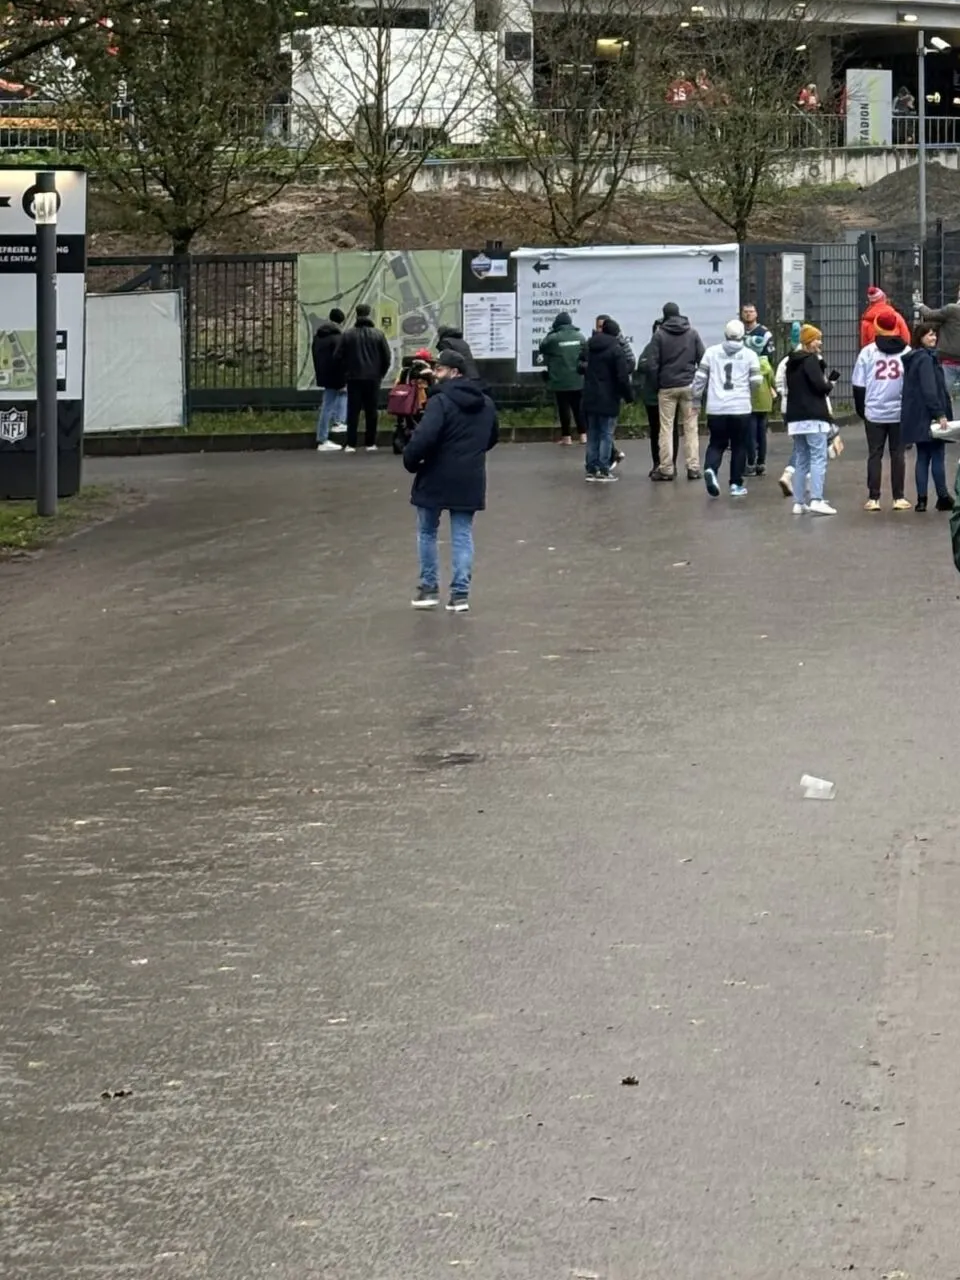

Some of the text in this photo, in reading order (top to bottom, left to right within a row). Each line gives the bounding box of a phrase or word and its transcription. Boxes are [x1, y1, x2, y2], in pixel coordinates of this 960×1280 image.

[532, 281, 557, 289] BLOCK
[698, 278, 724, 286] BLOCK
[532, 299, 582, 307] HOSPITALITY
[874, 359, 900, 381] 23
[723, 362, 734, 390] 1
[3, 422, 24, 437] NFL
